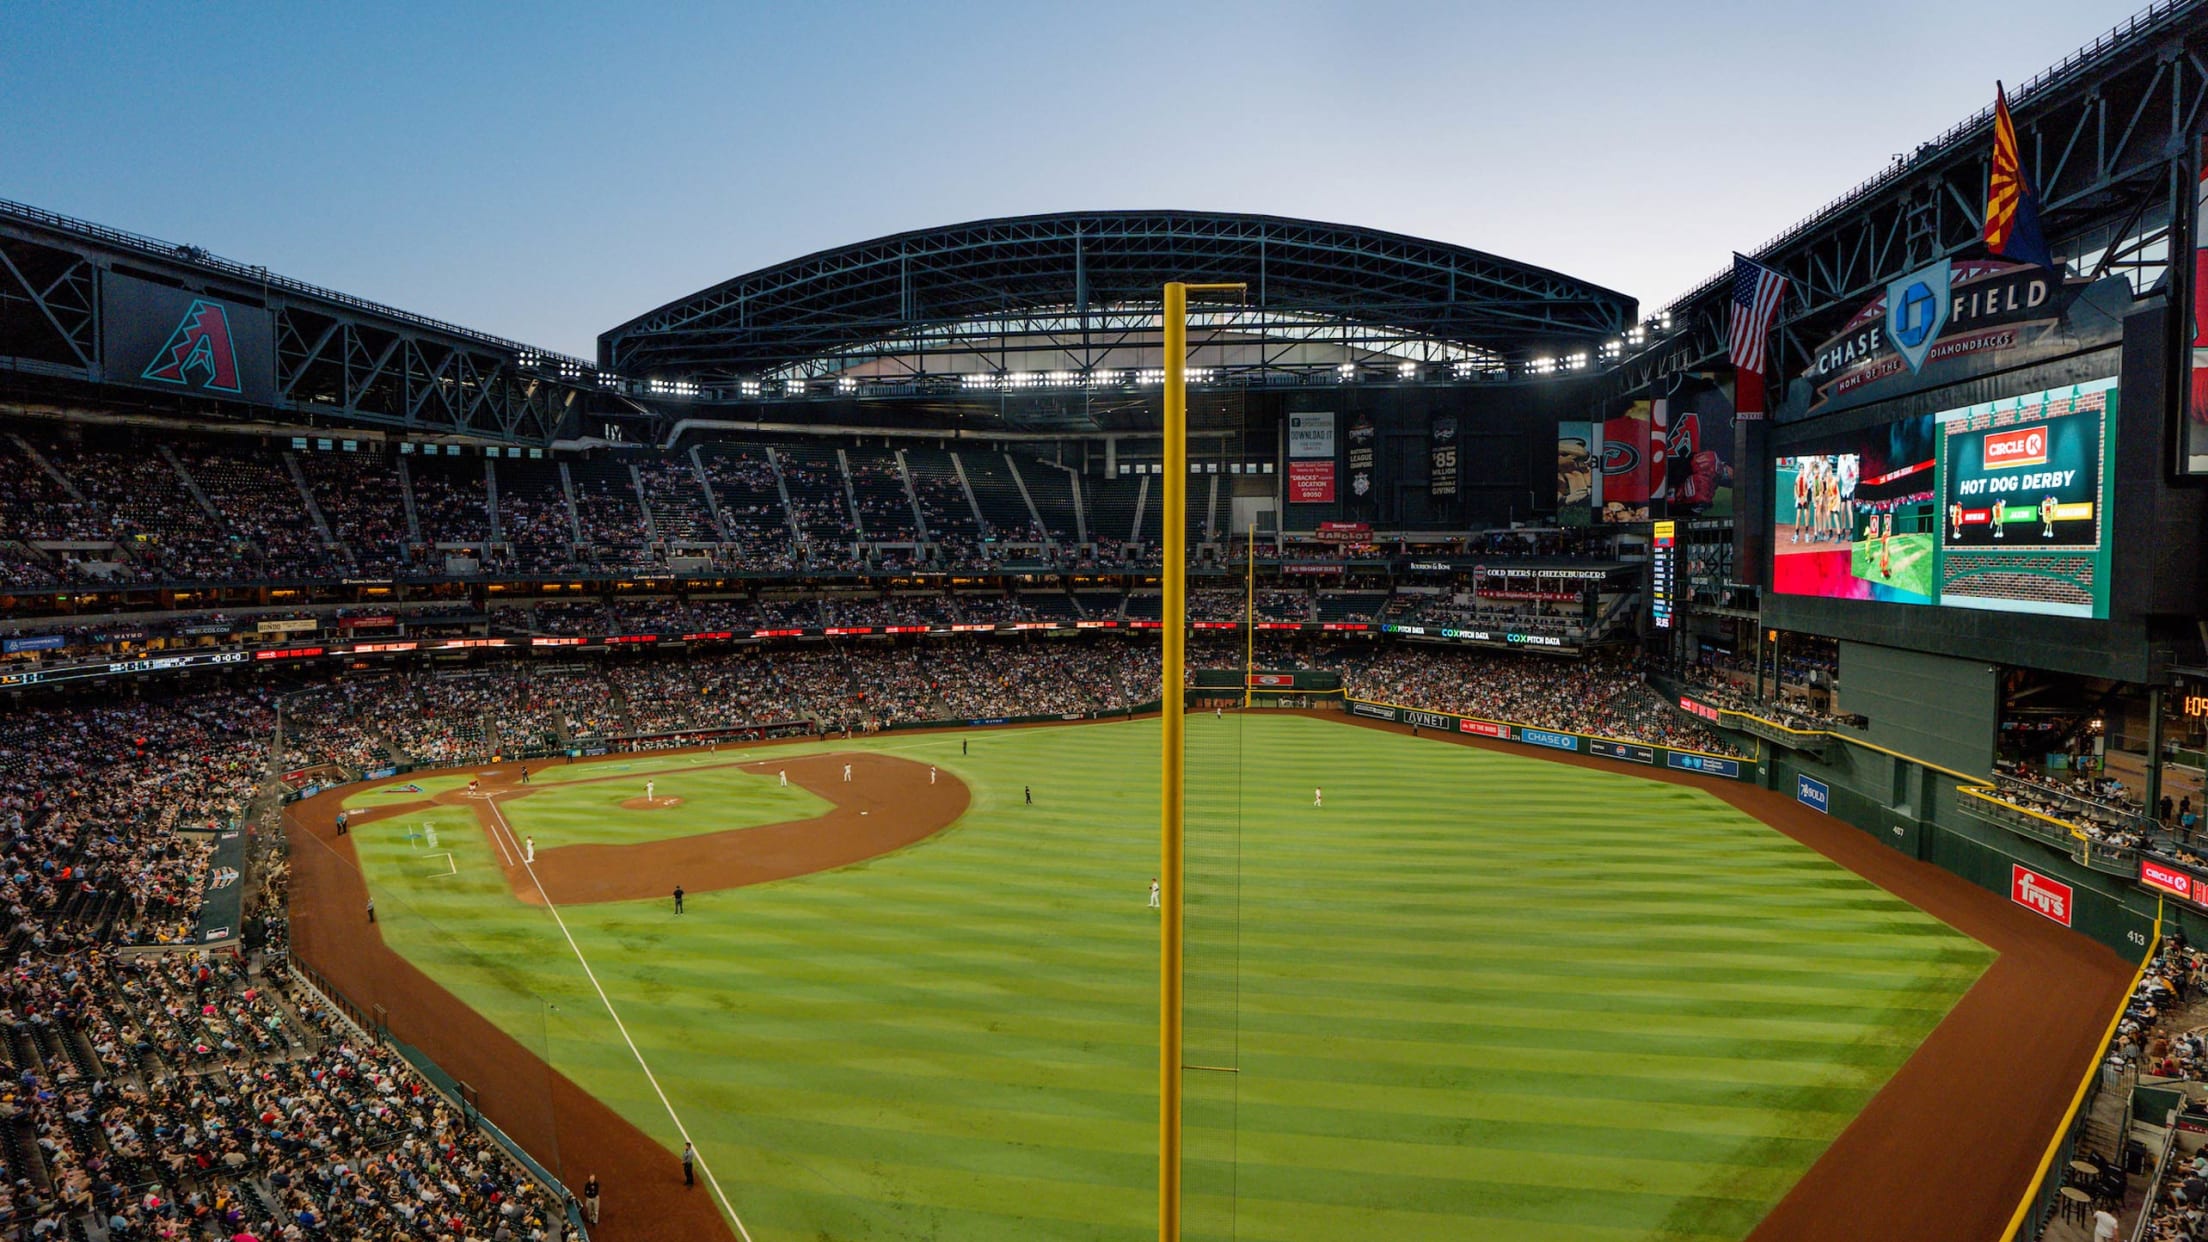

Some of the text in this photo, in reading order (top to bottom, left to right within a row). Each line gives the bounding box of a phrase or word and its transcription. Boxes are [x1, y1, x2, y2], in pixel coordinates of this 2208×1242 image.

[1952, 279, 2048, 323] FIELD
[1818, 327, 1880, 375] CHASE
[1930, 334, 2012, 359] DIAMONDBACKS
[1839, 360, 1898, 391] HOME OF THE
[1291, 430, 1333, 441] DOWNLOAD IT
[1989, 440, 2025, 457] CIRCLE
[1350, 454, 1373, 462] LEAGUE
[1432, 451, 1456, 468] $85
[1432, 468, 1456, 476] MILLION
[1960, 470, 2076, 495] HOT DOG DERBY
[1432, 487, 1456, 495] GIVING
[1317, 532, 1370, 541] SANDLOT
[1487, 569, 1506, 577] COLD
[1538, 570, 1606, 579] CHEESEBURGERS
[114, 632, 143, 640] WAYMO
[1381, 624, 1424, 635] COX PITCH DATA
[1441, 628, 1489, 640] COX PITCH DATA
[1507, 633, 1561, 646] COX PITCH DATA
[1408, 711, 1445, 727] AVNET
[1527, 732, 1560, 745] CHASE
[2145, 867, 2174, 885] CIRCLE
[2017, 873, 2066, 917] fry's
[2127, 930, 2145, 946] 413
